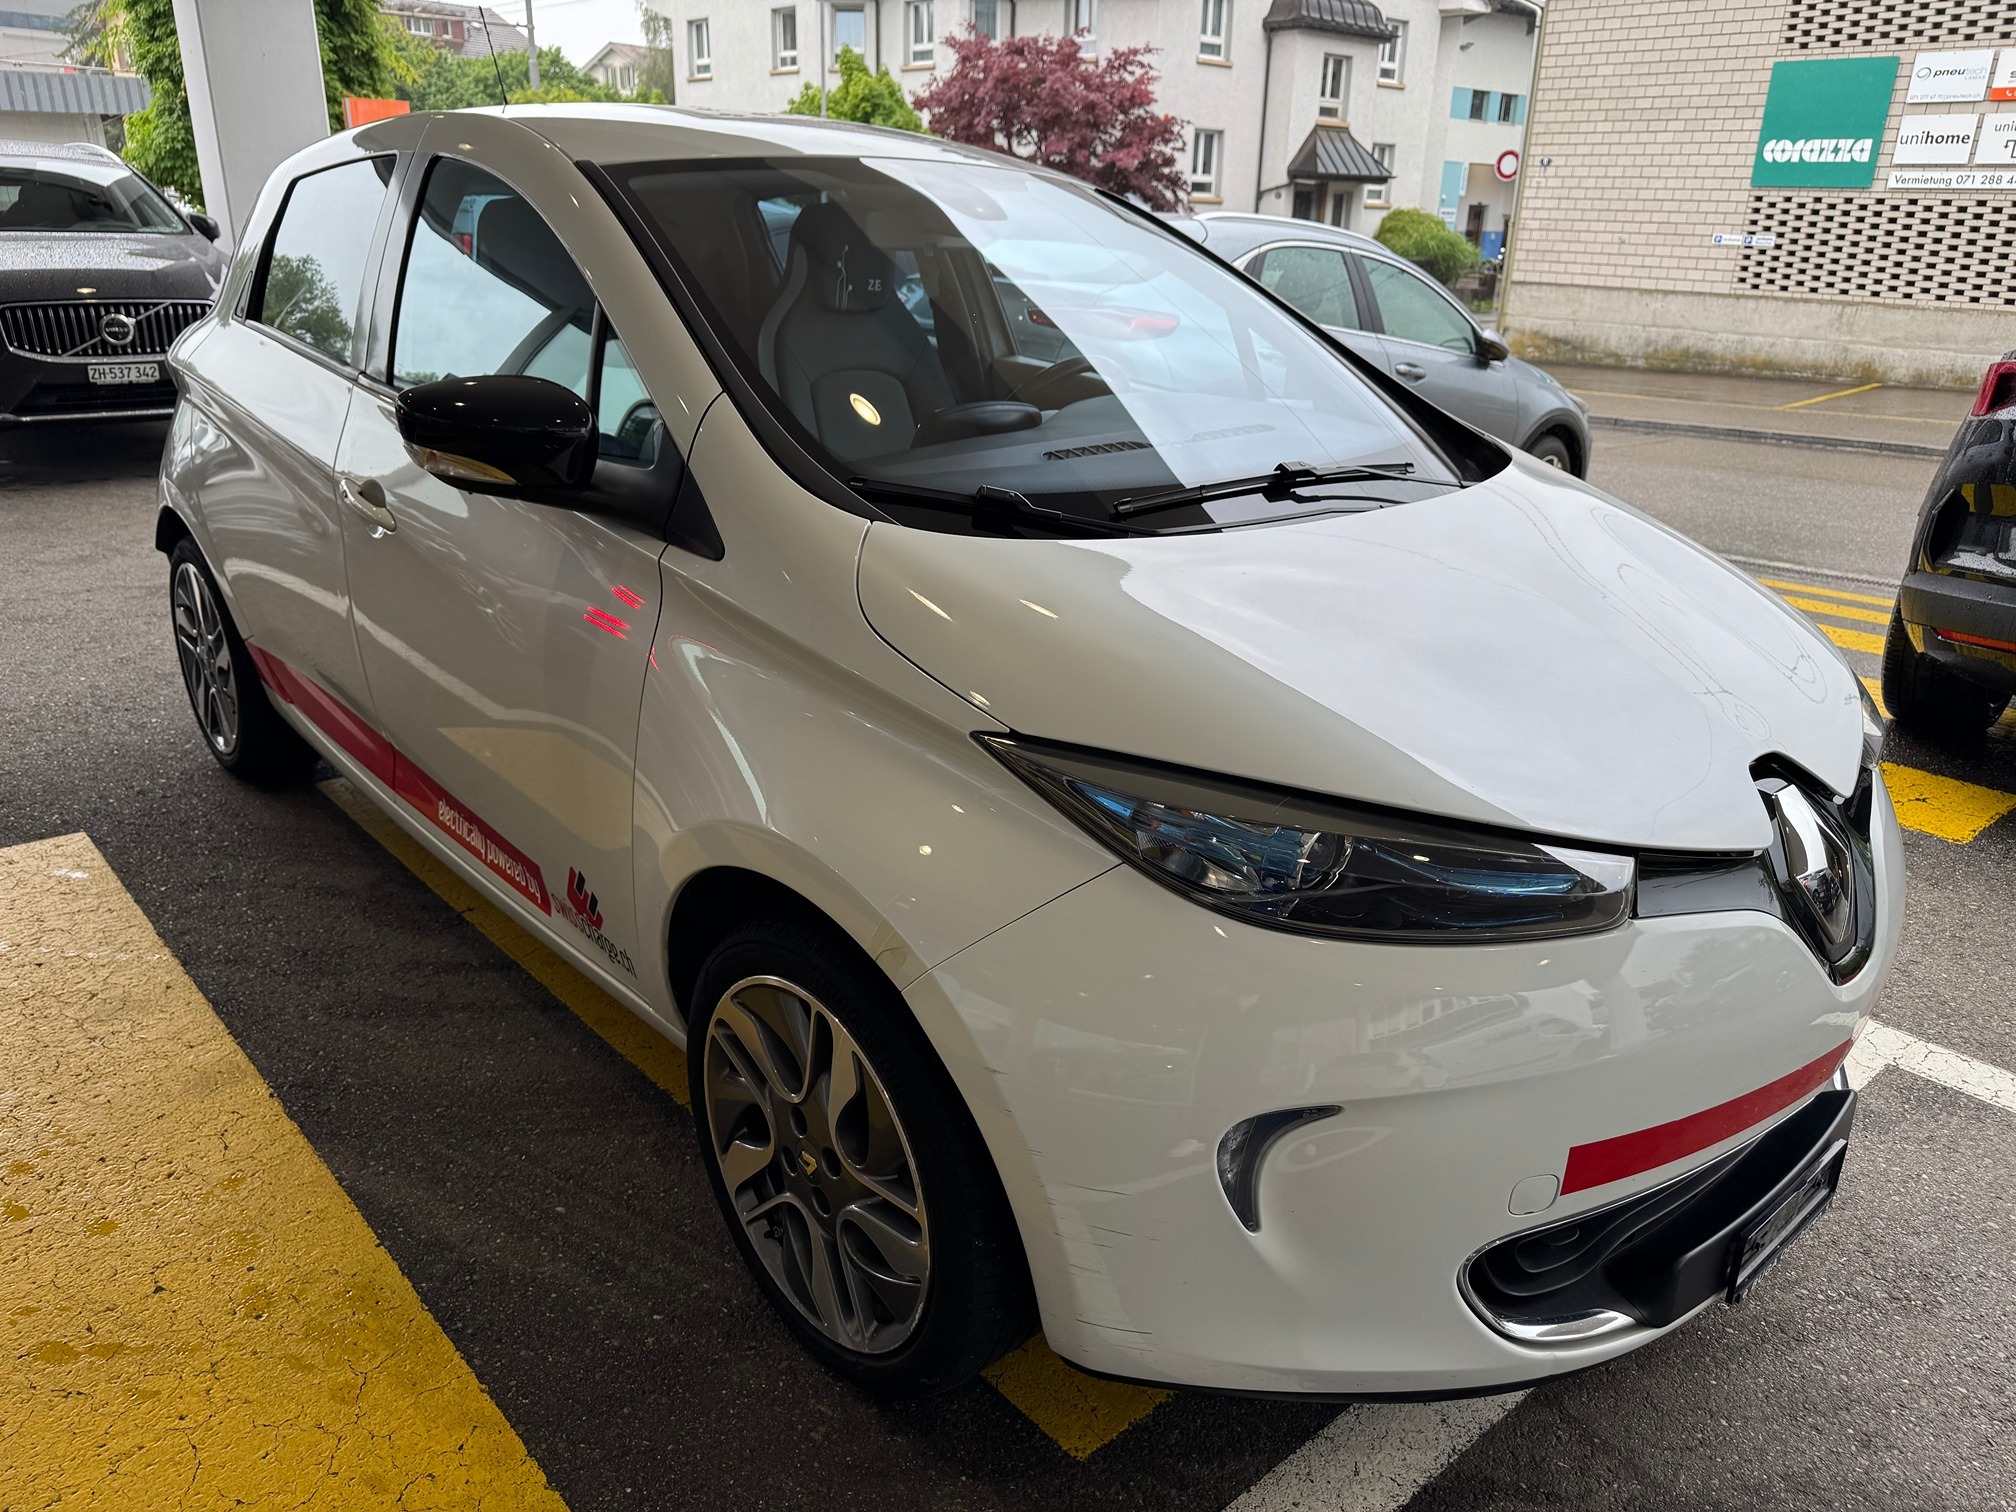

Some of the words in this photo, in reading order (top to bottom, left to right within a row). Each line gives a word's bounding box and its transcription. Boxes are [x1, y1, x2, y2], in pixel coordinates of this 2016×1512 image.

[1933, 66, 1987, 78] pneutech
[1899, 130, 1971, 145] unihome
[1762, 138, 1873, 163] corazza
[1894, 174, 1953, 187] Vermietung
[1955, 174, 1976, 185] 071
[1980, 174, 2003, 185] 288
[134, 365, 158, 379] 342
[438, 798, 486, 860] electrically
[486, 838, 527, 887] powered
[524, 866, 541, 904] by
